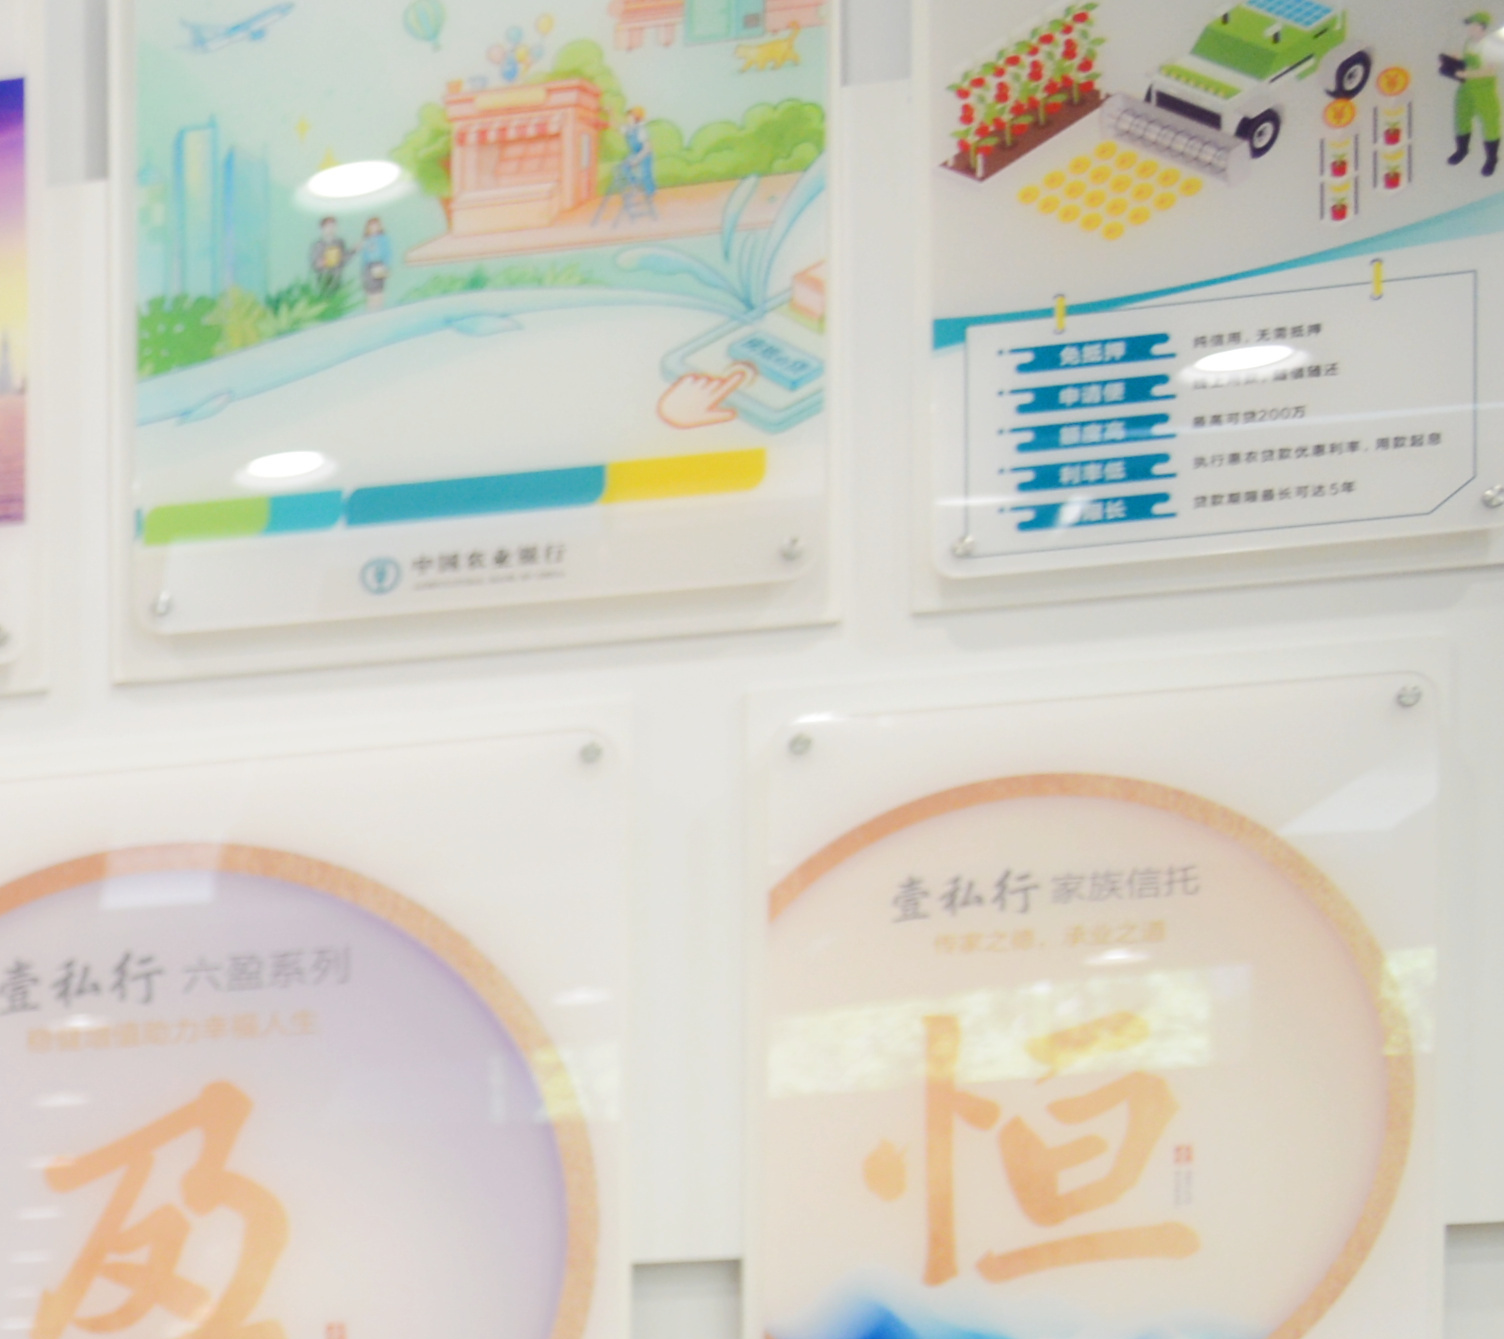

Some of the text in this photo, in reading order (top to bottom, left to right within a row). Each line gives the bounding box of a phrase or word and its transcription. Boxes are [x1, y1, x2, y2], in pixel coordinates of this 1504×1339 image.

[412, 543, 565, 574] 中国农业银行
[891, 864, 1200, 923] 壹私行 家族信托
[181, 945, 352, 994] 六盈系列
[861, 1010, 1202, 1286] 恒
